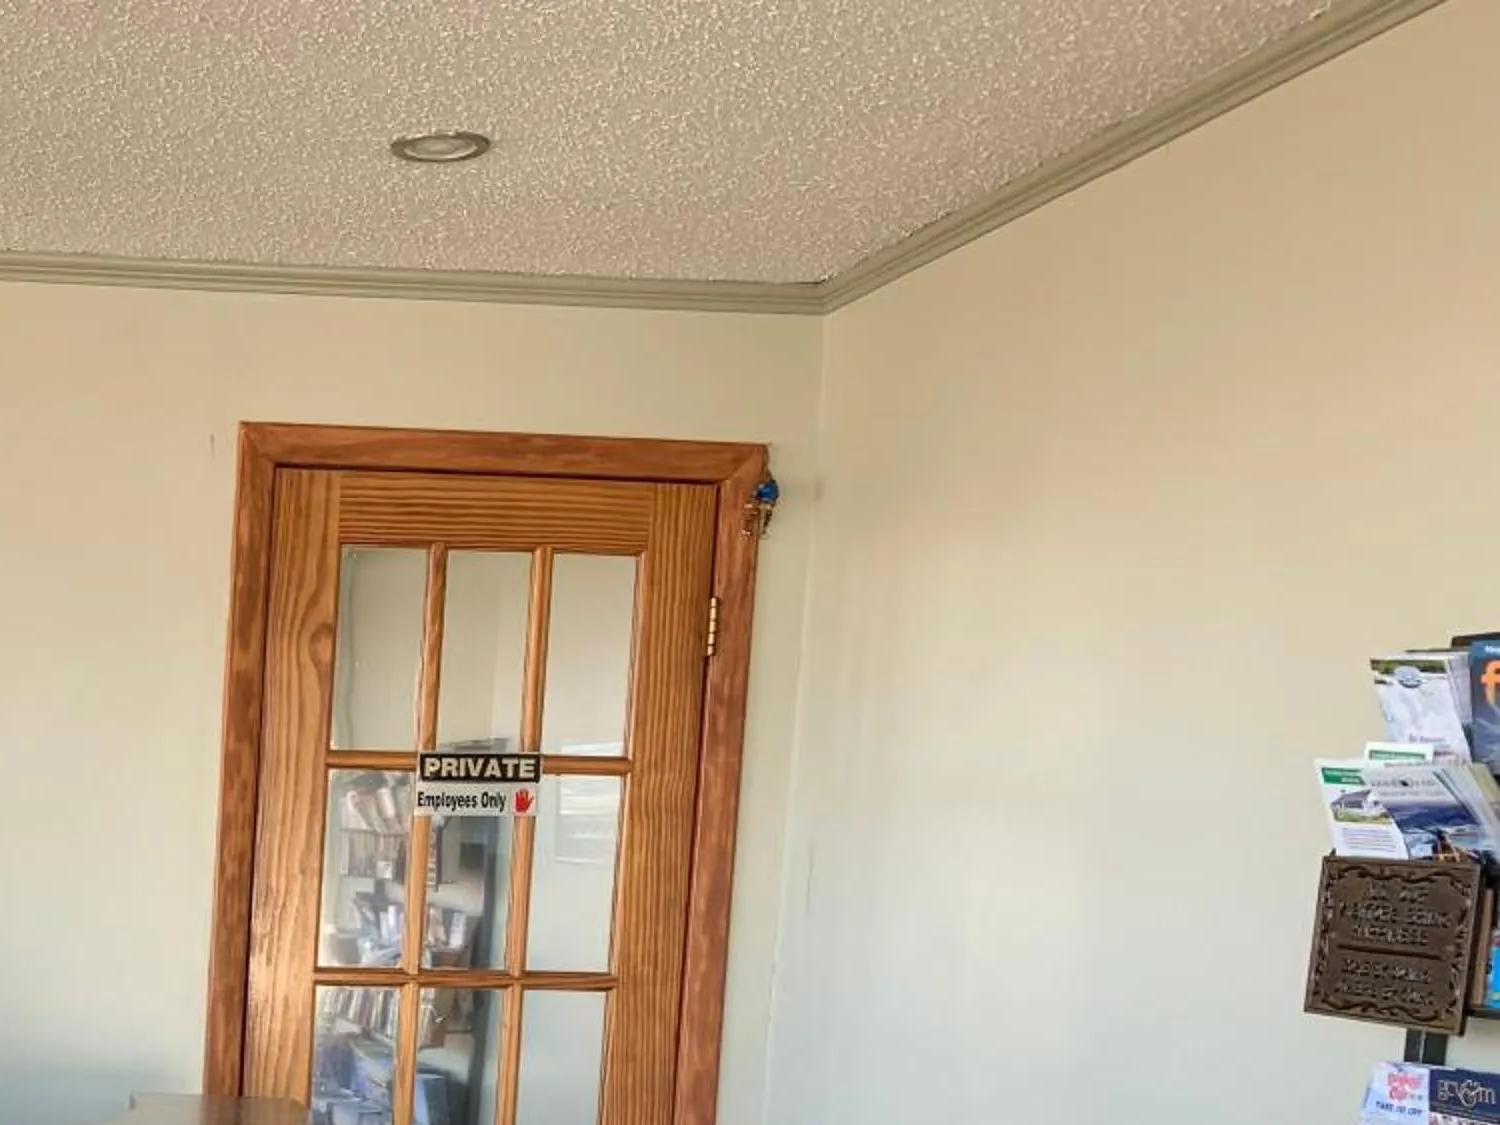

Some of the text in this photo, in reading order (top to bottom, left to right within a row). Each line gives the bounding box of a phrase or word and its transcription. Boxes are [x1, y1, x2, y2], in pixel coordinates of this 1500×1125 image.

[424, 757, 536, 778] PRIVATE
[417, 791, 507, 813] Employees Only
